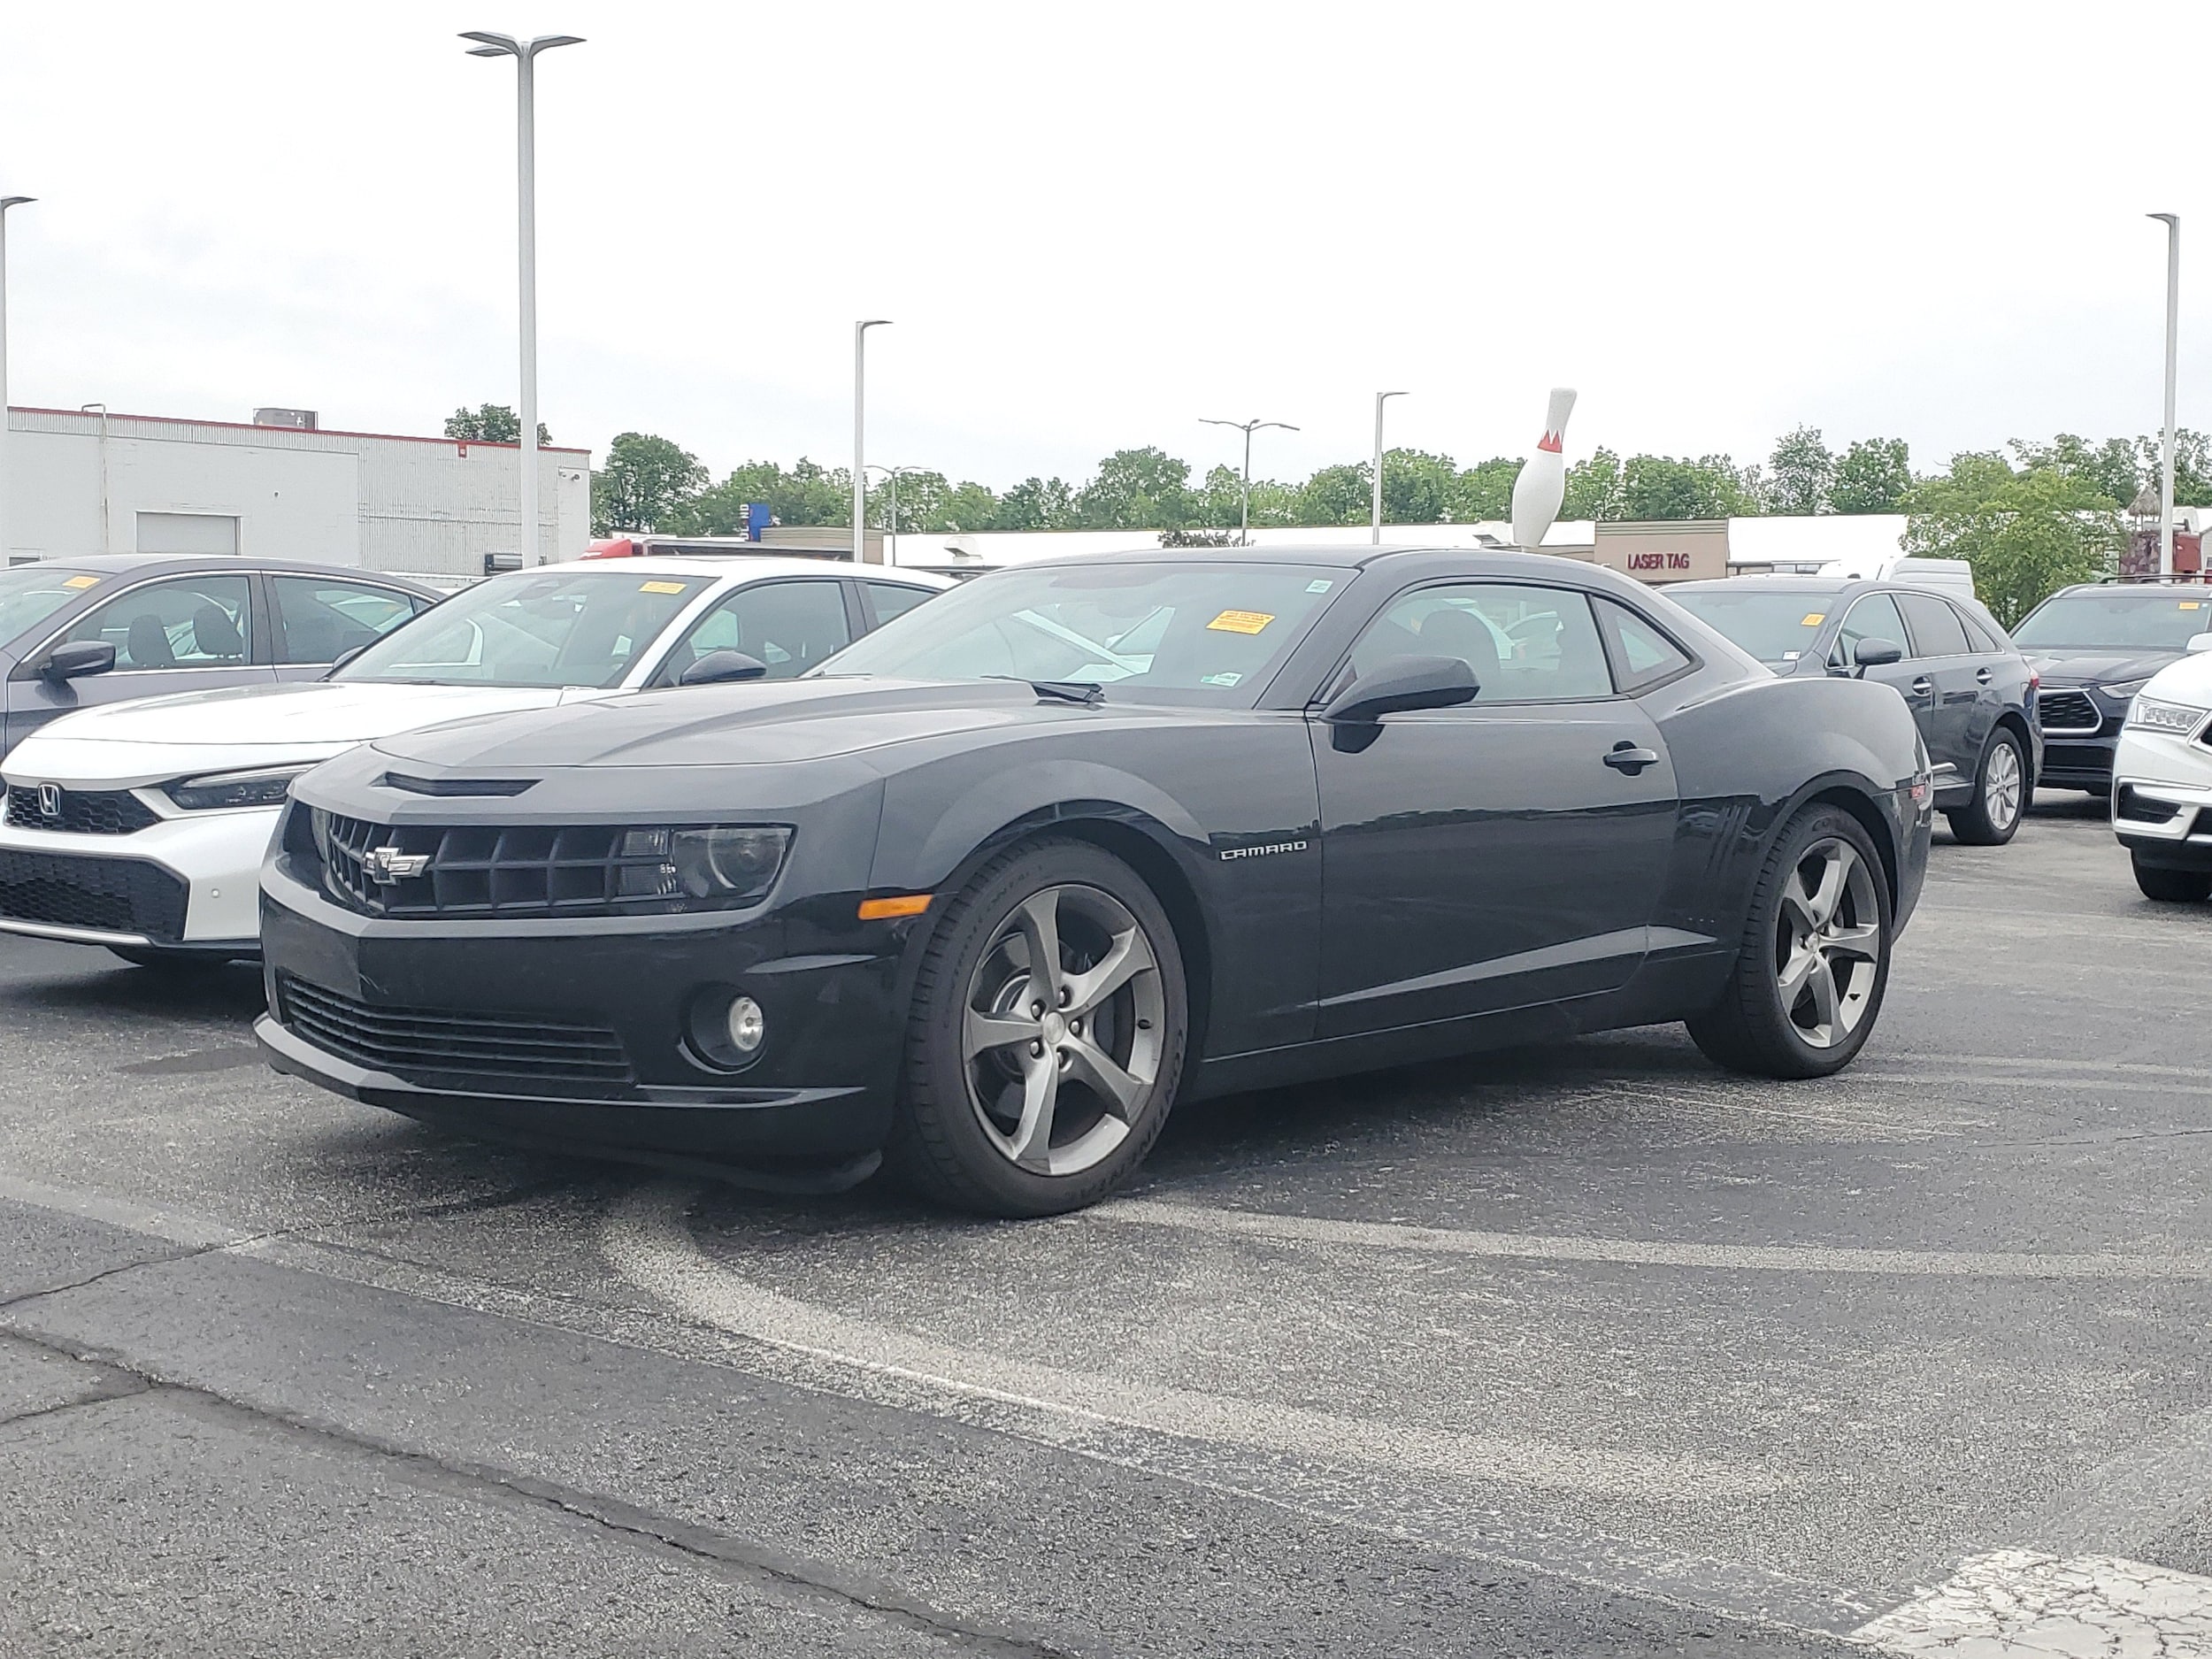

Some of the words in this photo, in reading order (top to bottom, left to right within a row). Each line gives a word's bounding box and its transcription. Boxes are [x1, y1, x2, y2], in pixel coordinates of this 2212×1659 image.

[1628, 553, 1663, 570] LASER
[1666, 553, 1689, 569] TAG
[1220, 841, 1308, 861] CAMARO
